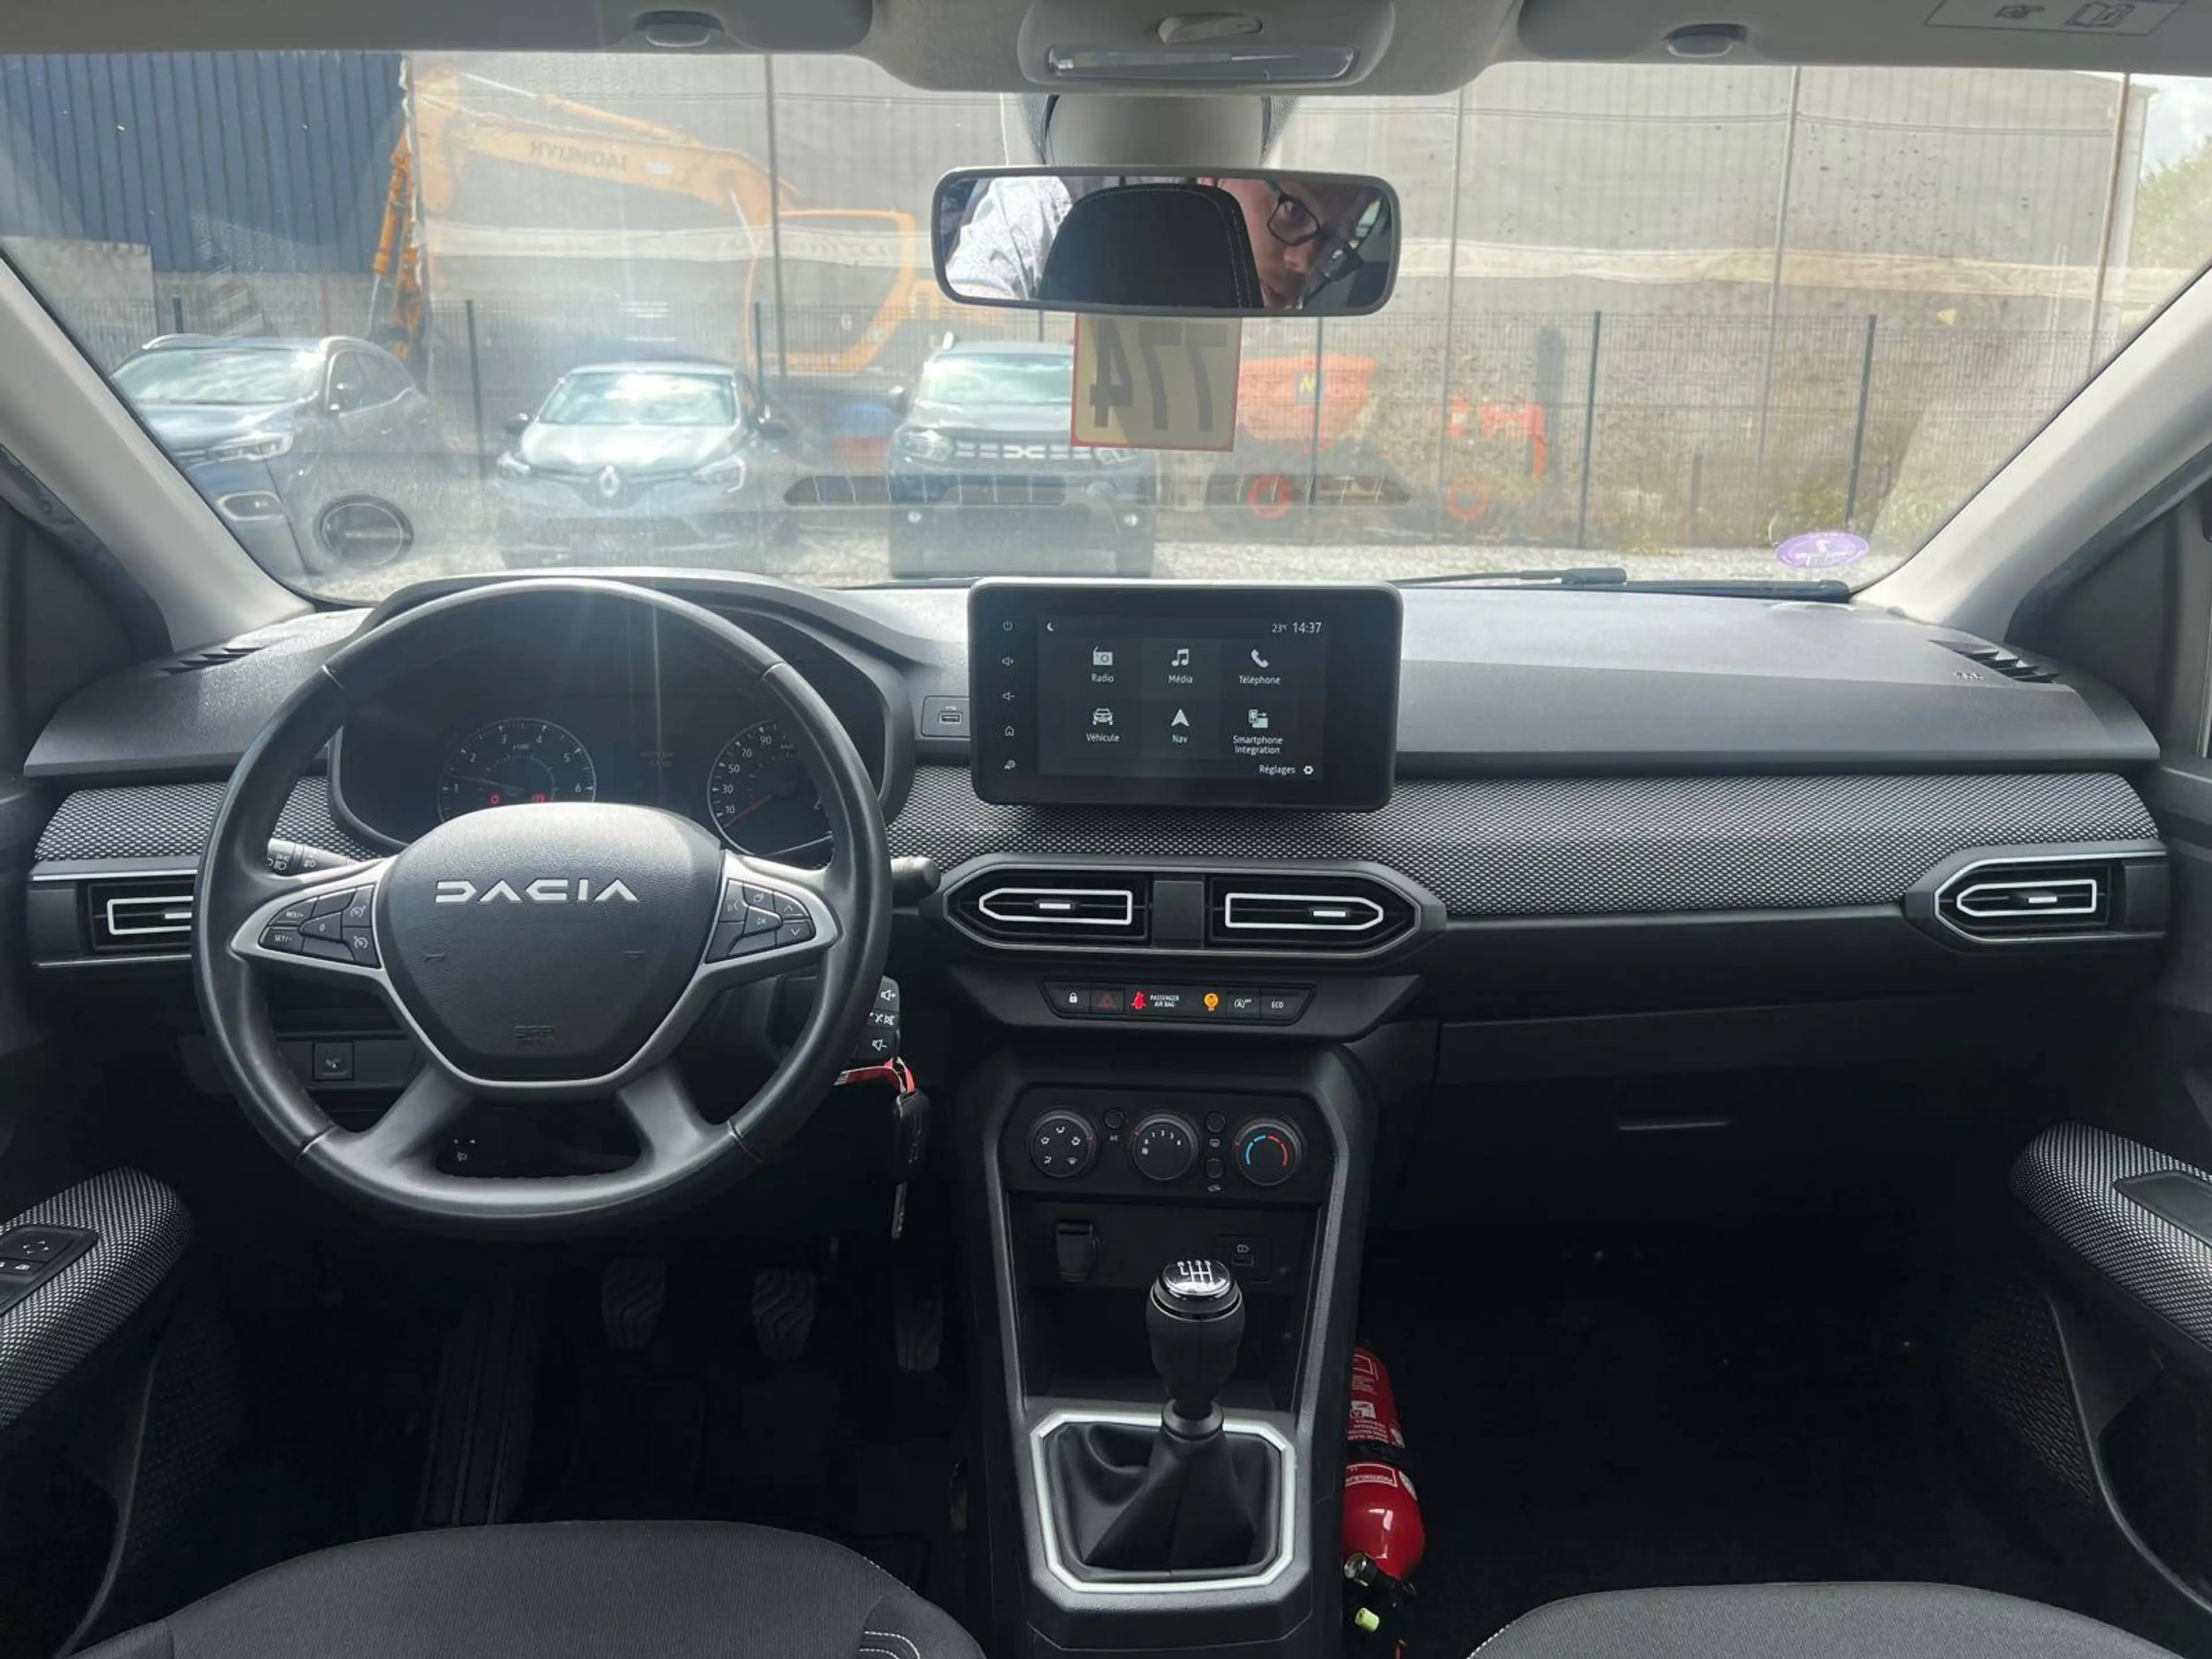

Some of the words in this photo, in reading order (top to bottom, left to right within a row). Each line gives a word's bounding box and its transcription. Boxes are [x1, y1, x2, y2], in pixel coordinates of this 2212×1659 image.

[1292, 622, 1323, 633] 14:37
[1091, 673, 1114, 683] Radio
[1168, 674, 1193, 684] Média
[1238, 675, 1281, 686] Téléphone
[501, 734, 507, 744] 3
[536, 734, 543, 744] 4
[760, 734, 772, 745] 90
[1086, 732, 1120, 742] Véhicule
[1172, 734, 1189, 743] Nav
[1233, 734, 1283, 745] Smartphone
[743, 748, 752, 758] 70
[1234, 745, 1280, 756] Integration
[469, 753, 478, 763] 2
[563, 753, 570, 763] 5
[728, 764, 741, 774] 50
[1259, 764, 1296, 776] Réglages
[575, 783, 582, 793] 6
[722, 785, 734, 795] 30
[725, 805, 735, 815] 10
[435, 878, 641, 903] DACIA
[1271, 1001, 1284, 1009] ECO
